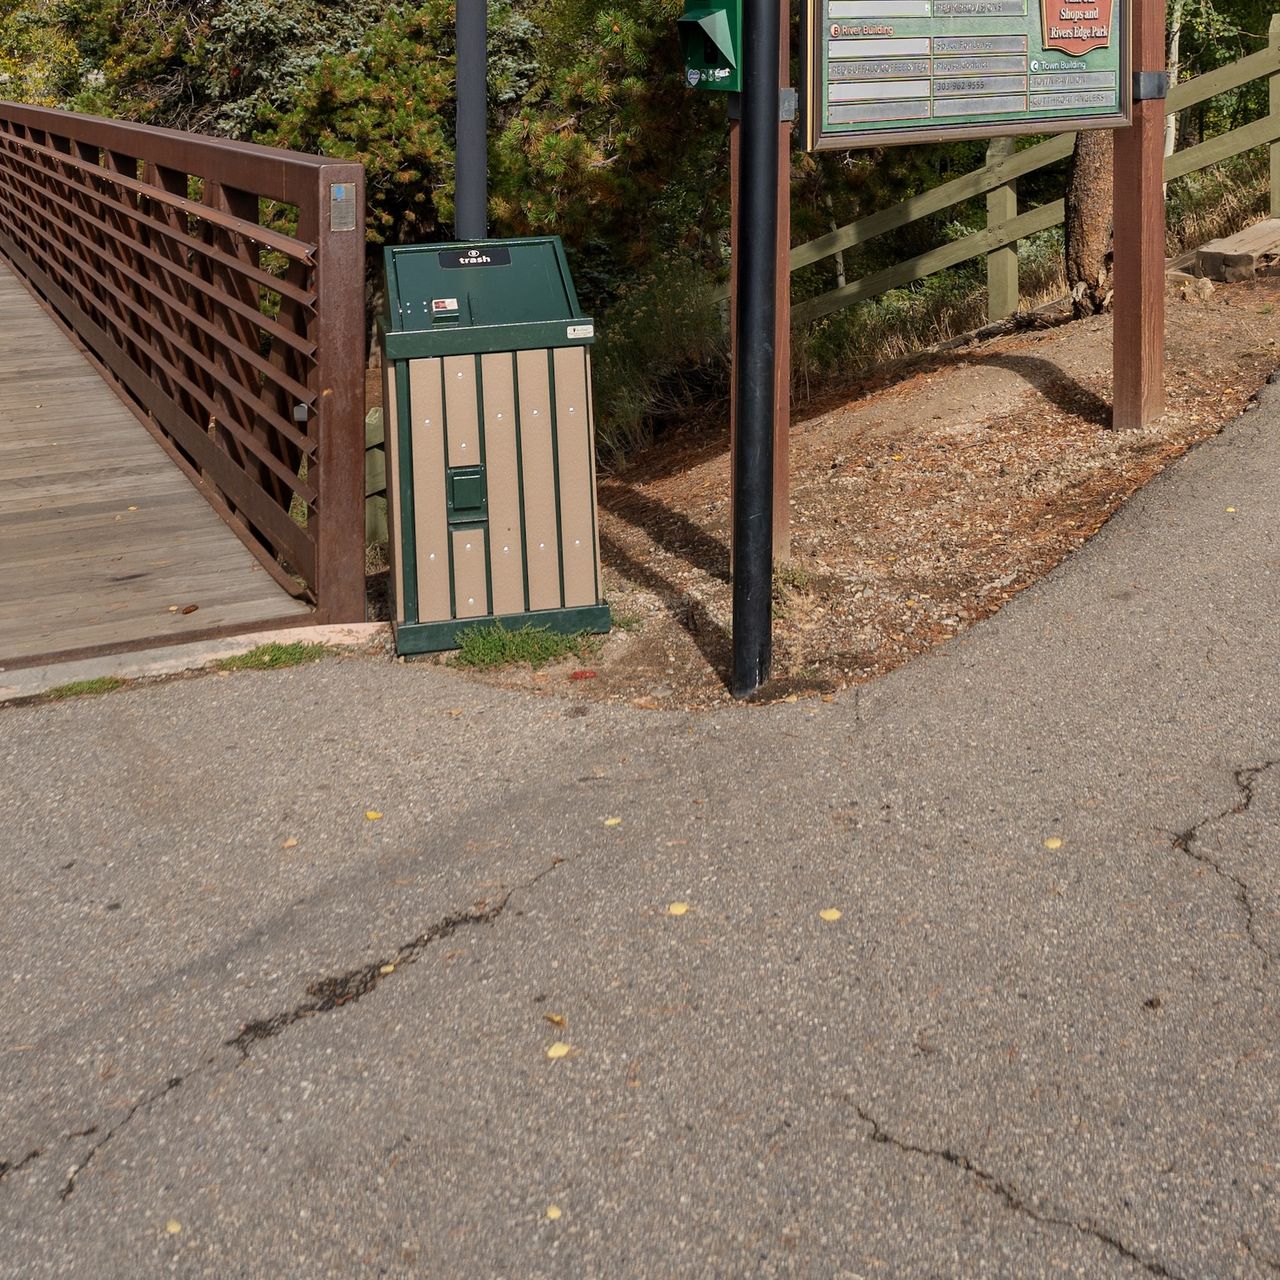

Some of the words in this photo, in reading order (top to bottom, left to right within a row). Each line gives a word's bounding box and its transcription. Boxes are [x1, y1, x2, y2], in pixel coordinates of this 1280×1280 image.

[1060, 7, 1085, 23] Shops
[1085, 7, 1099, 20] and
[842, 25, 861, 35] River
[863, 24, 894, 36] Building
[1050, 26, 1073, 39] Rivers
[1073, 25, 1091, 40] Edge
[1091, 24, 1108, 38] Park
[1041, 61, 1060, 71] Town
[1060, 60, 1087, 71] Building
[459, 255, 491, 264] trash
